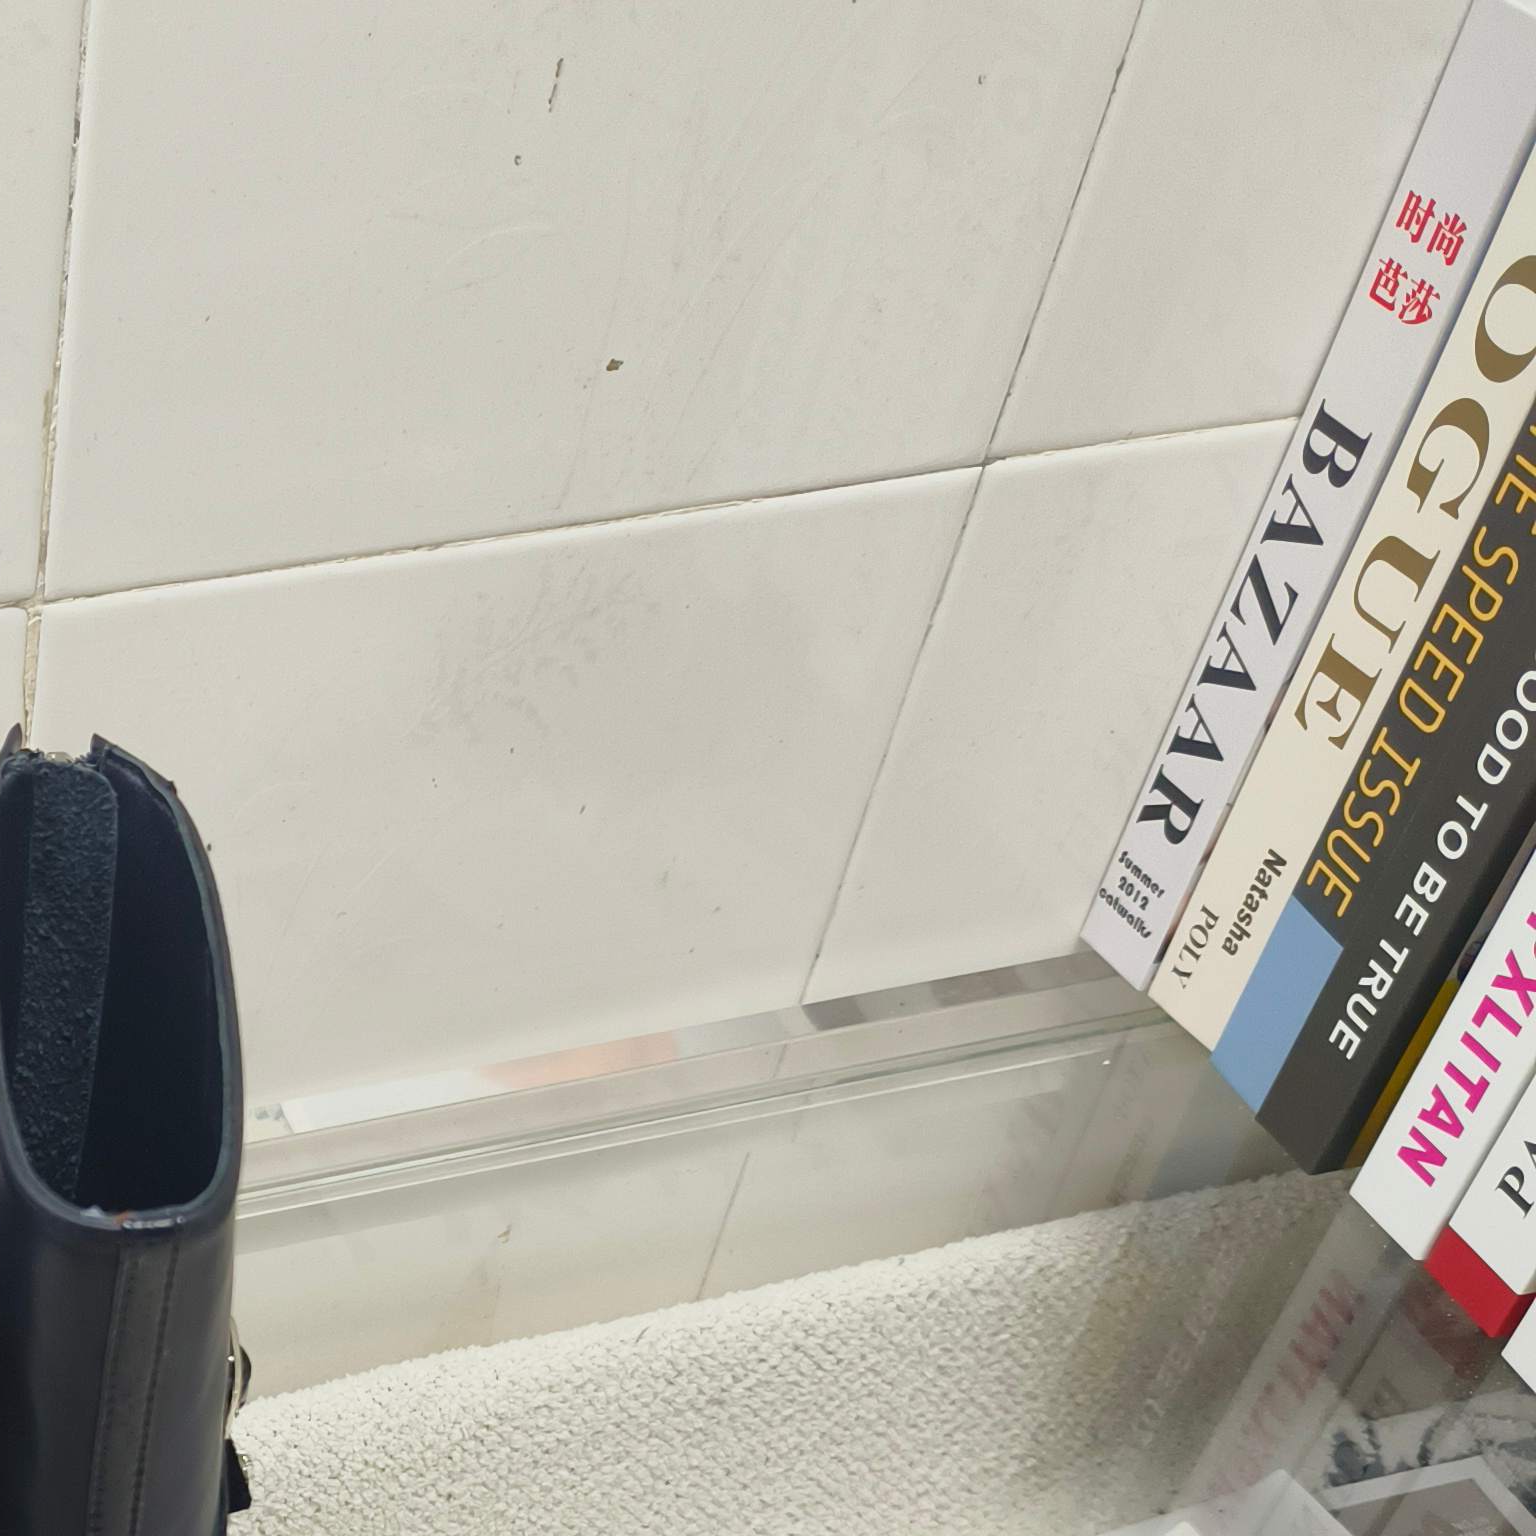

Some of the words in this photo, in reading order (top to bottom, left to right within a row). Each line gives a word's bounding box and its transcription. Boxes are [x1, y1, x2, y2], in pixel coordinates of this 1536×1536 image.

[1395, 189, 1469, 267] 时尚
[1368, 256, 1441, 326] 芭莎
[1293, 254, 1536, 750] OGUE
[1136, 398, 1373, 846] BAZAAR
[1399, 525, 1519, 734] SPEED
[1477, 651, 1536, 785] OOD
[1306, 726, 1421, 918] ISSUE
[1437, 794, 1489, 860] TO
[1117, 876, 1150, 911] 2012
[1118, 850, 1165, 899] Summer
[1221, 848, 1288, 956] Natasha
[1394, 861, 1447, 936] BE
[1171, 904, 1220, 989] POLY
[1327, 938, 1410, 1061] TRUE
